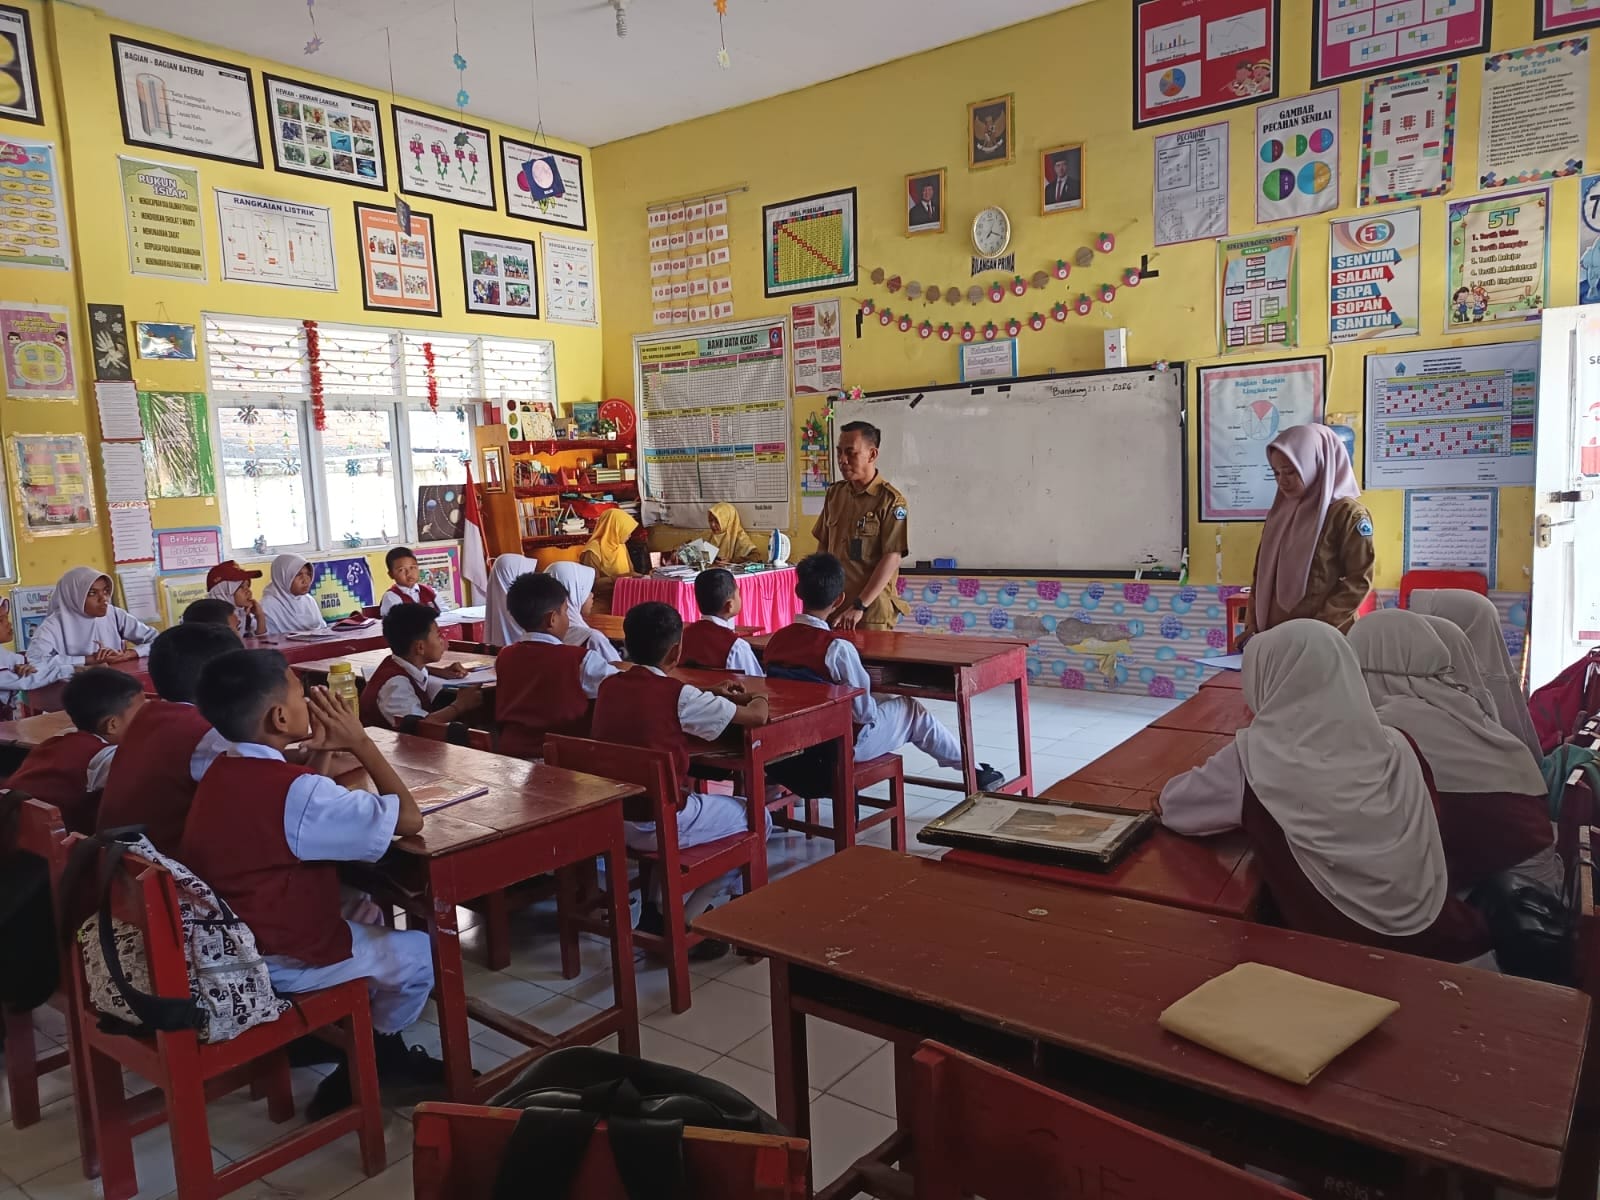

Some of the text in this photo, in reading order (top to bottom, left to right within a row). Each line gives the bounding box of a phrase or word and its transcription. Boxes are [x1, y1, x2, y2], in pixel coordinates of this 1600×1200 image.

[124, 51, 148, 64] BAGIAN
[154, 59, 178, 71] BAGIAN
[179, 62, 205, 77] BATERAI
[276, 88, 295, 97] HEWAN
[299, 94, 318, 102] HEWAN
[319, 98, 338, 106] LANGKA
[1279, 104, 1314, 120] GAMBAR
[1263, 109, 1332, 134] PECAHAN SENILAI
[138, 174, 177, 188] RUKUN
[154, 186, 188, 200] ISLAM
[233, 197, 315, 217] RANGKAIAN LISTRIK
[1488, 207, 1521, 229] 5T
[1365, 224, 1387, 242] 5S
[971, 251, 1016, 278] BILANGAN PRIMA
[1337, 249, 1395, 269] SENYUM
[1337, 267, 1384, 284] SALAM
[1337, 285, 1373, 300] SAPA
[1337, 298, 1383, 315] SOPAN
[1336, 313, 1392, 331] SANTUN
[707, 334, 758, 350] BANK DATA KELAS
[170, 535, 208, 543] Be Happy
[321, 598, 341, 609] NADA
